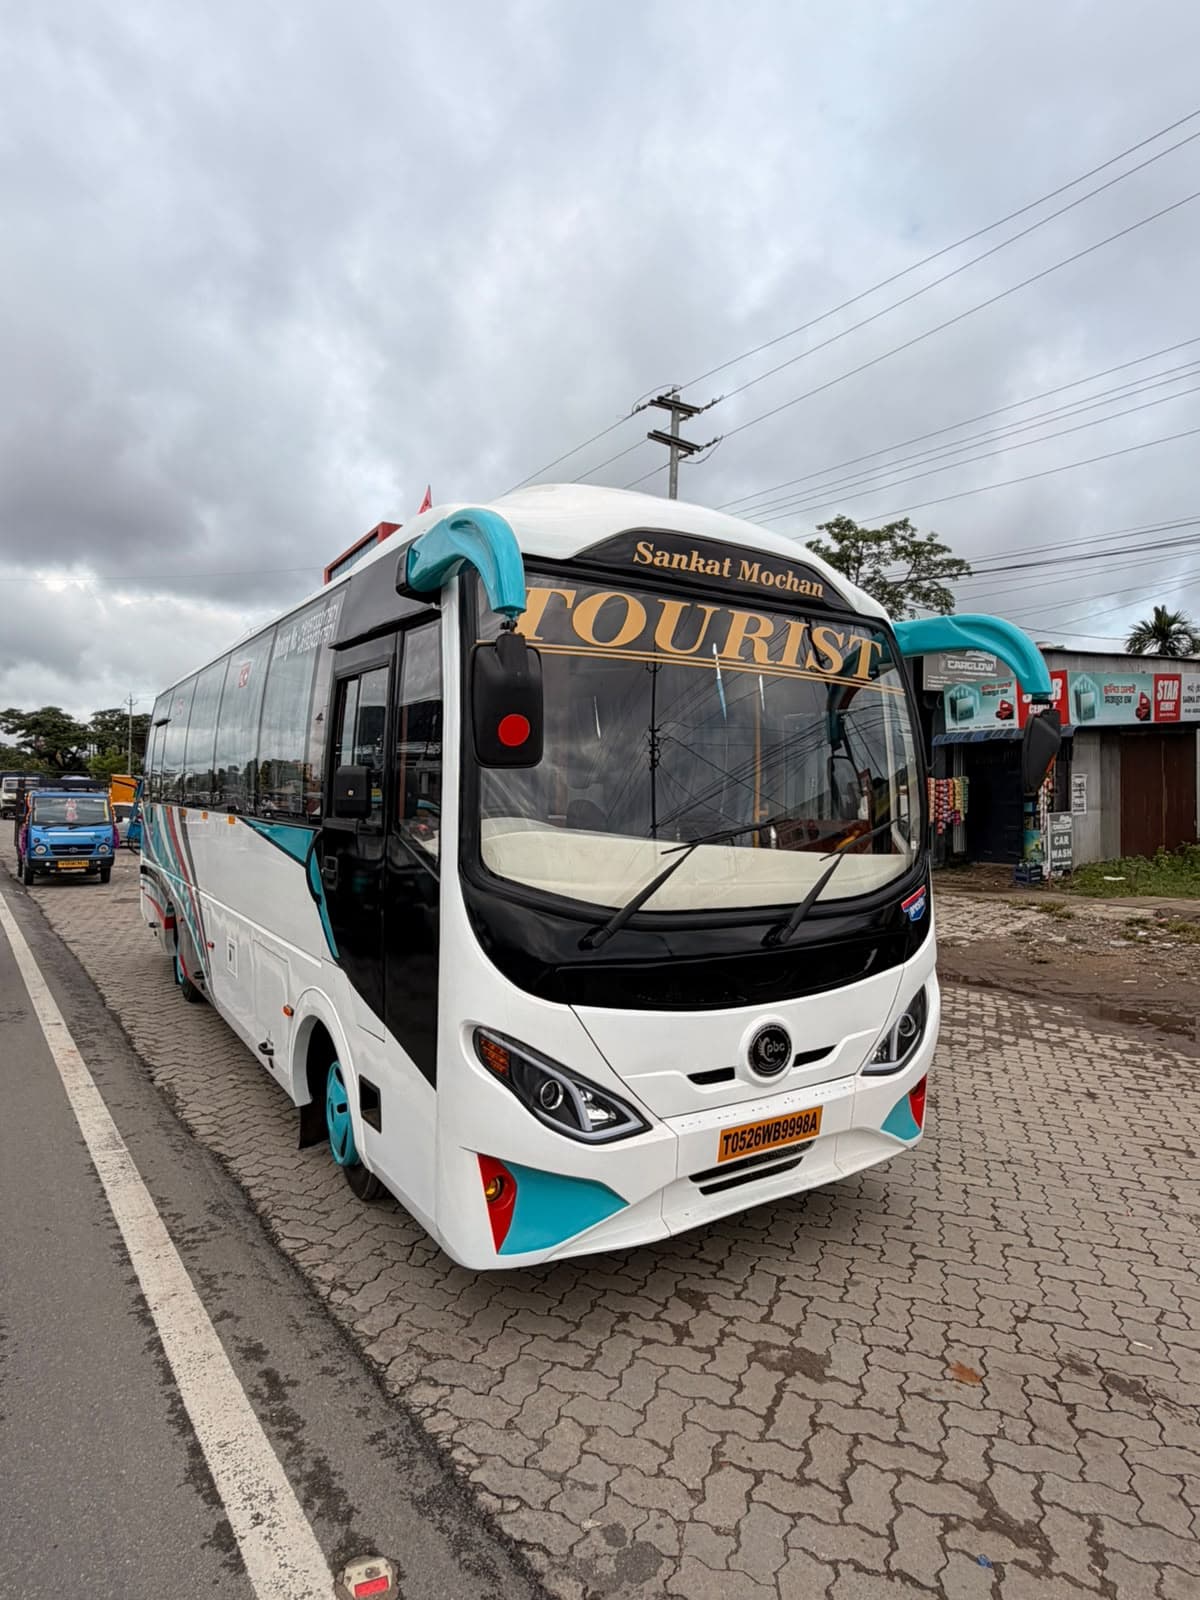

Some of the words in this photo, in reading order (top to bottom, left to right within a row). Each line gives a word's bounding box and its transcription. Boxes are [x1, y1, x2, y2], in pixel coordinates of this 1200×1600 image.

[633, 541, 732, 579] Sankat
[738, 562, 824, 598] Mochan
[514, 587, 882, 681] TOURIST
[947, 660, 994, 671] CARGLOW
[1157, 680, 1180, 700] STAR
[1054, 836, 1069, 845] CAR
[1051, 848, 1072, 858] WASH
[723, 1111, 817, 1156] T0526WB9998A
